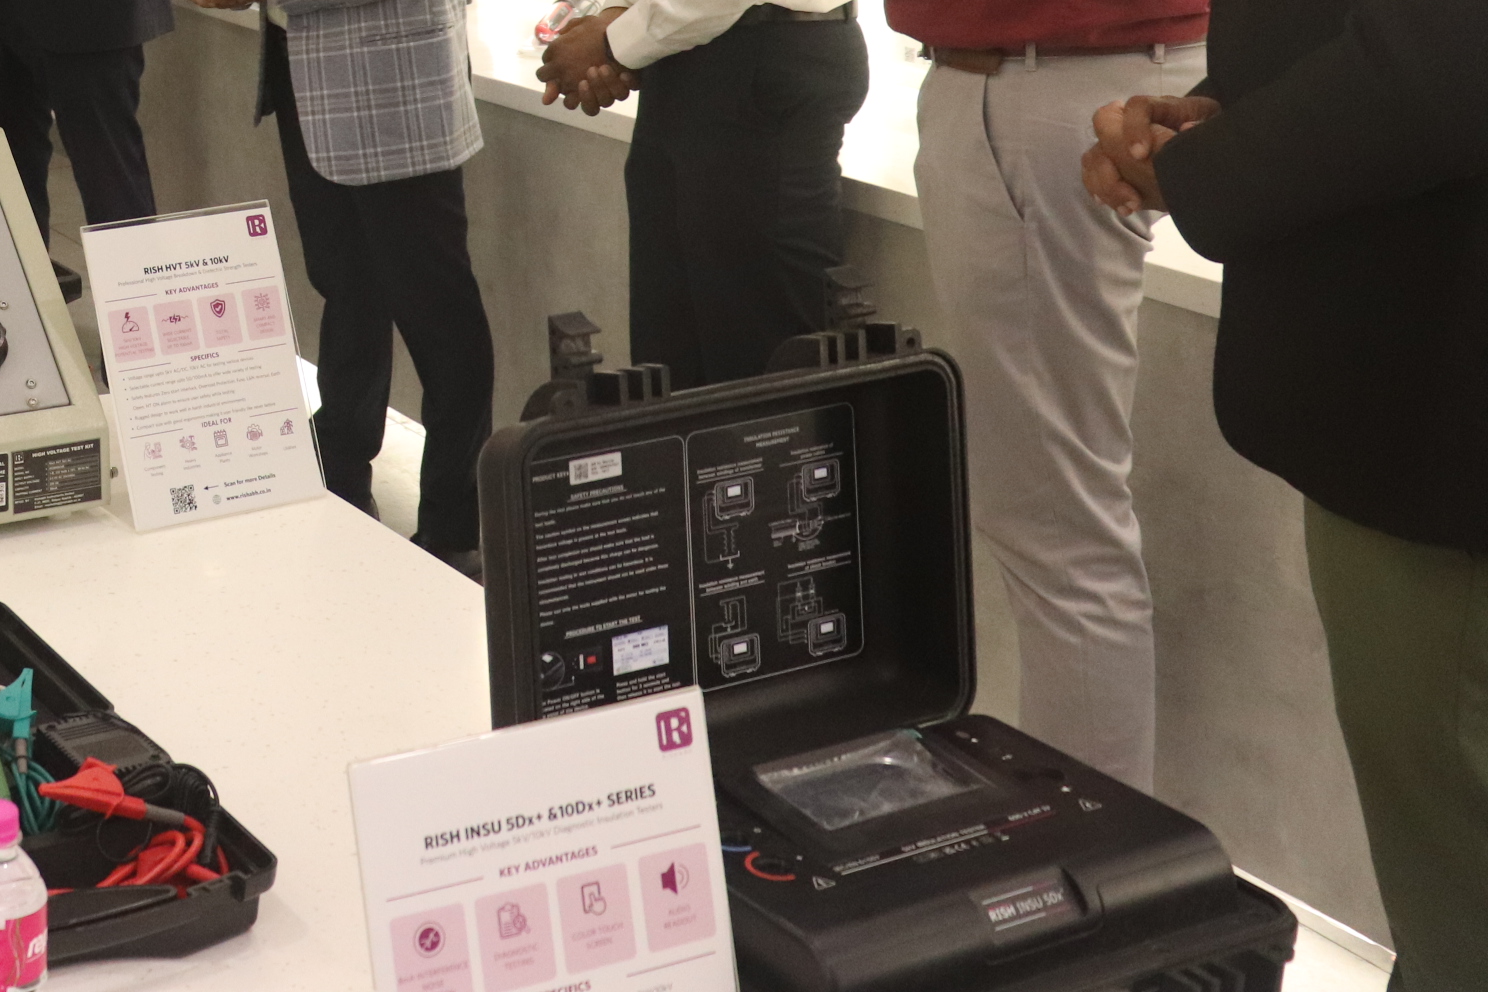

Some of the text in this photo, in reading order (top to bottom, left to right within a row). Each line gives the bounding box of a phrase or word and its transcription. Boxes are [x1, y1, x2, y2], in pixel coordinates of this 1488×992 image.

[143, 255, 229, 276] RISH HVT 5kV & 10kV
[177, 282, 219, 293] ADVANTAGES
[190, 351, 220, 363] SPECIFICS
[201, 416, 232, 428] IDEAL FOR
[46, 447, 70, 455] VOLTAGE
[223, 479, 236, 488] Scan
[244, 475, 257, 483] more
[257, 471, 276, 481] Details
[226, 488, 272, 501] www.rishabh.co.in
[423, 782, 657, 851] RISH INSU 5Dx+ &10Dx+ SERIES
[498, 844, 599, 878] KEY ADVANTAGES
[988, 895, 1043, 923] RISH INSU
